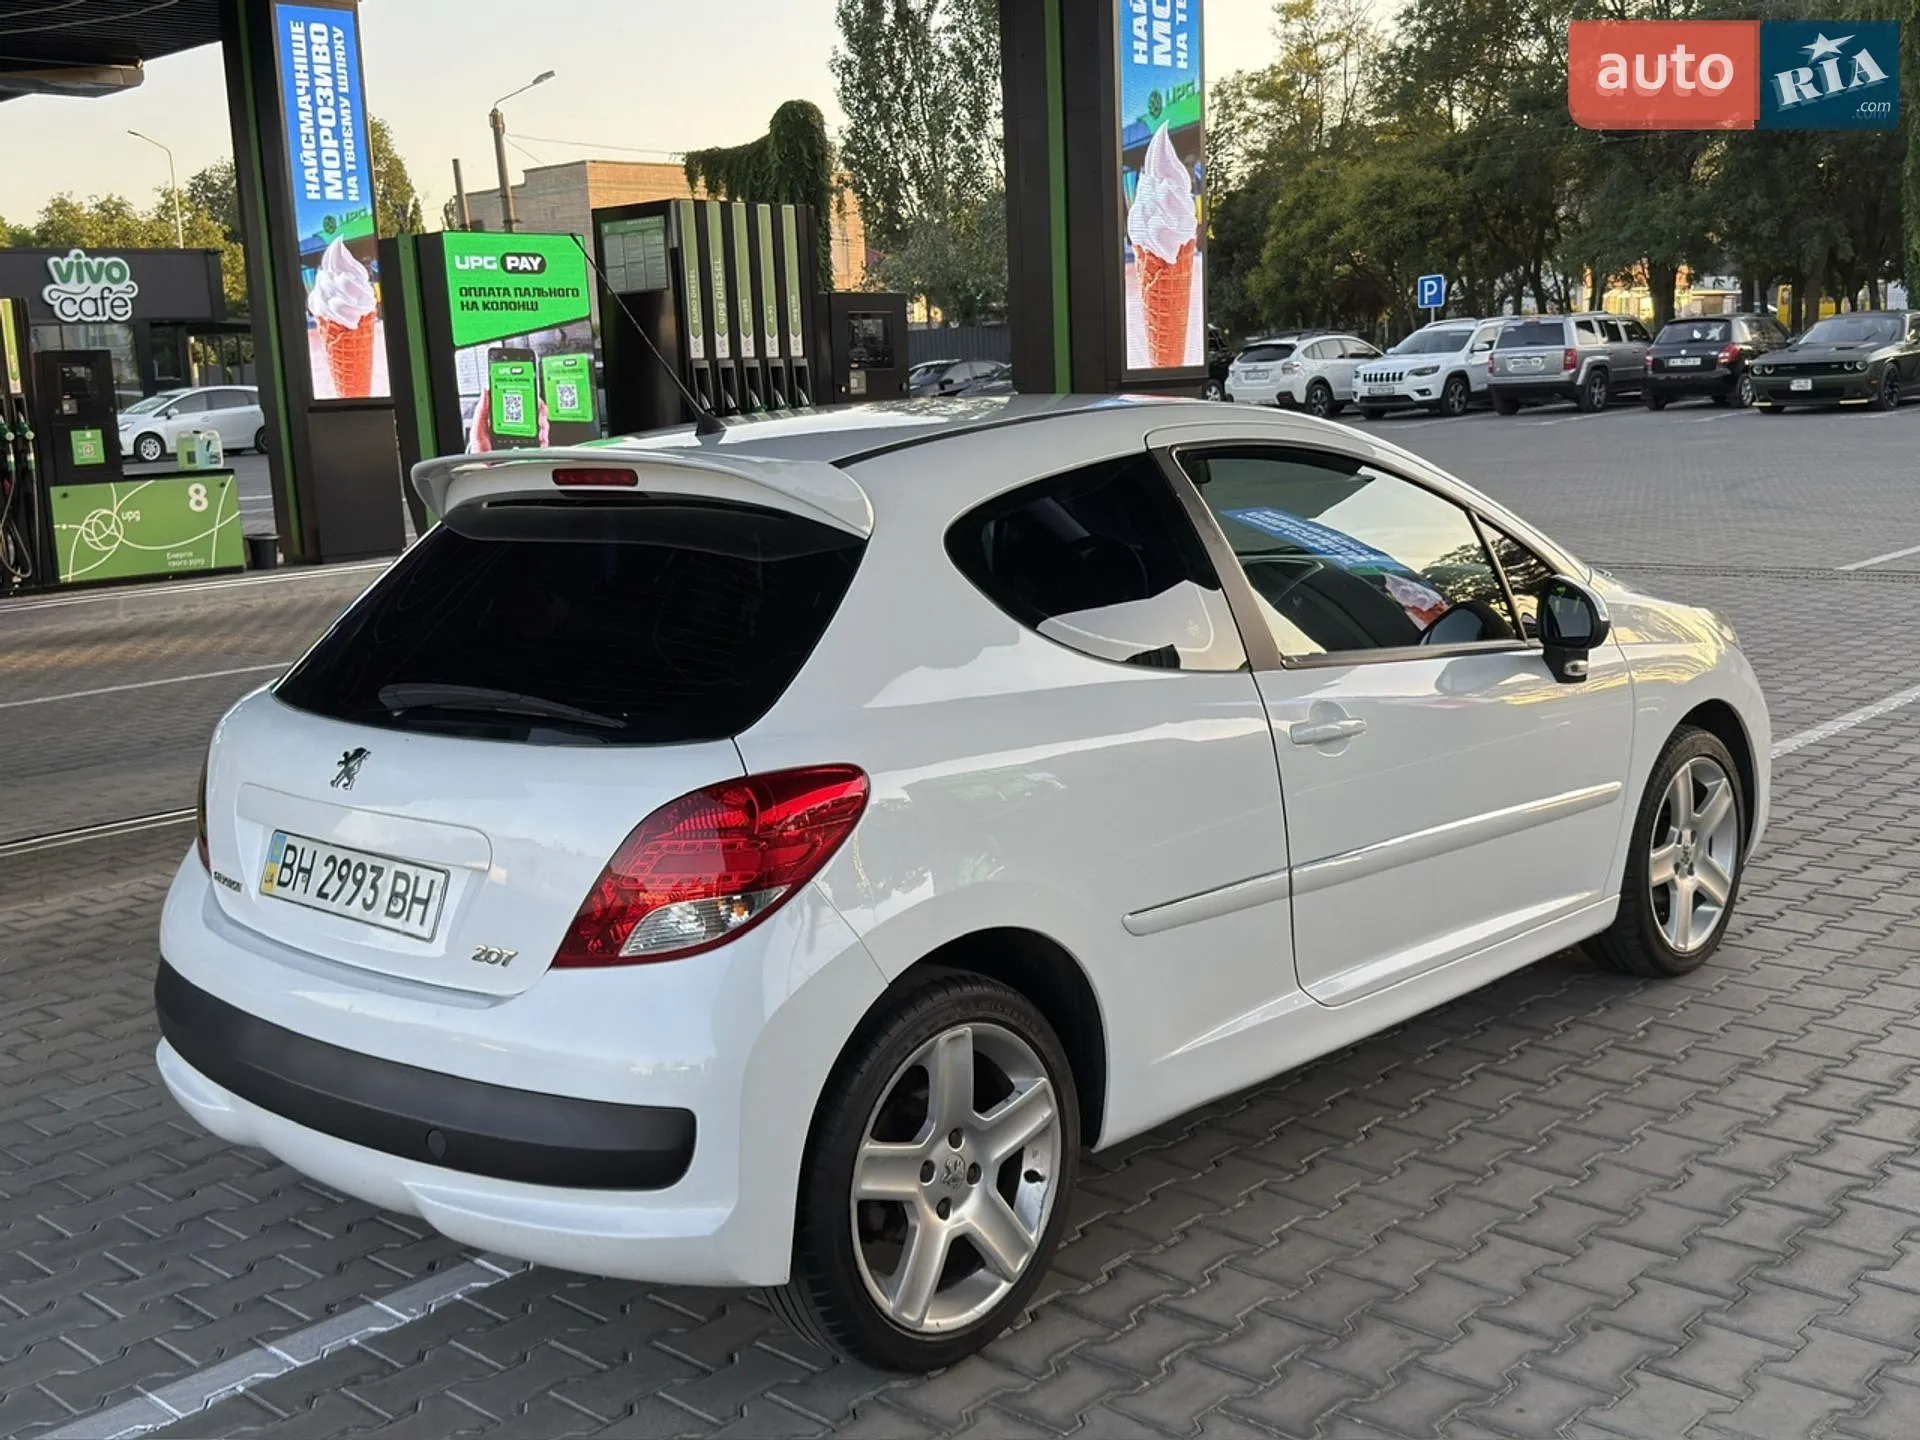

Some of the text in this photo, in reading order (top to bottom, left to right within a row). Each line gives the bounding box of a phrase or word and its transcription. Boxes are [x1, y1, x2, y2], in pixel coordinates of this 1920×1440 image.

[1176, 32, 1188, 69] НА
[290, 20, 320, 200] НАЙСМАЧНІШЕ
[309, 22, 343, 200] МОРОЗИВО
[332, 26, 360, 201] НА ТВОЄМУ ШЛЯХУ
[53, 252, 127, 285] vivo
[454, 255, 541, 271] UPG PAY
[459, 286, 580, 298] ОПЛАТА ПАЛЬНОГО
[460, 300, 479, 312] НА
[1424, 280, 1438, 304] P
[188, 483, 208, 512] 8
[121, 510, 141, 522] upg
[277, 843, 317, 895] BH
[316, 854, 385, 912] 2993
[385, 870, 435, 927] BH
[472, 944, 518, 967] 207
